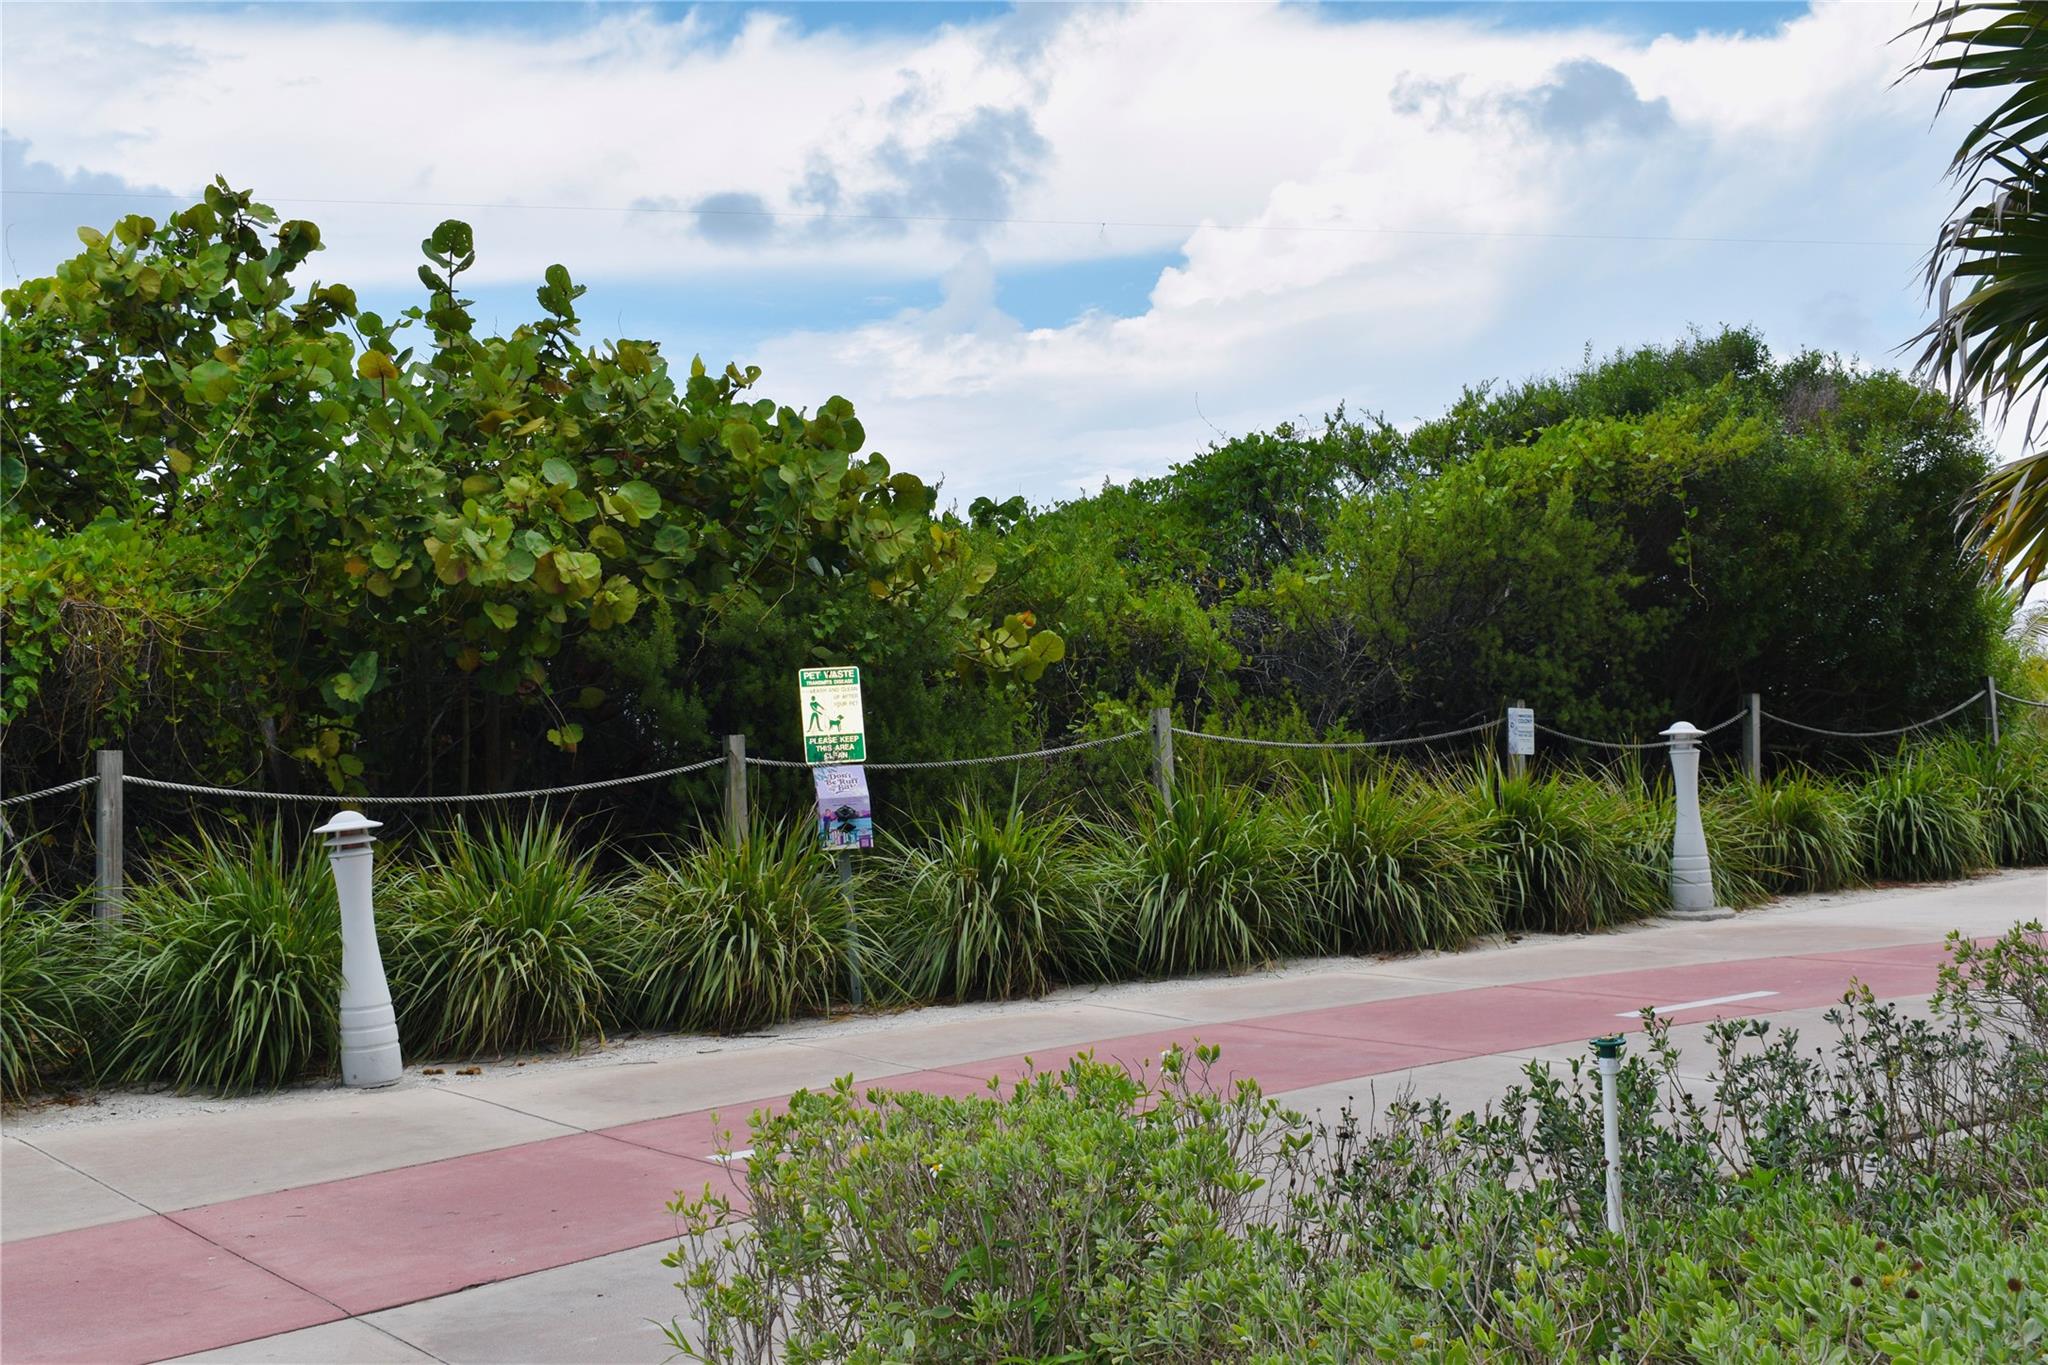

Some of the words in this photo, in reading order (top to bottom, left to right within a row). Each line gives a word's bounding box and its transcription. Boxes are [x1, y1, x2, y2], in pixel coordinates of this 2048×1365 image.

[803, 671, 821, 680] PET
[823, 669, 855, 679] WASTE
[839, 735, 860, 743] KEEP
[834, 743, 855, 751] AREA
